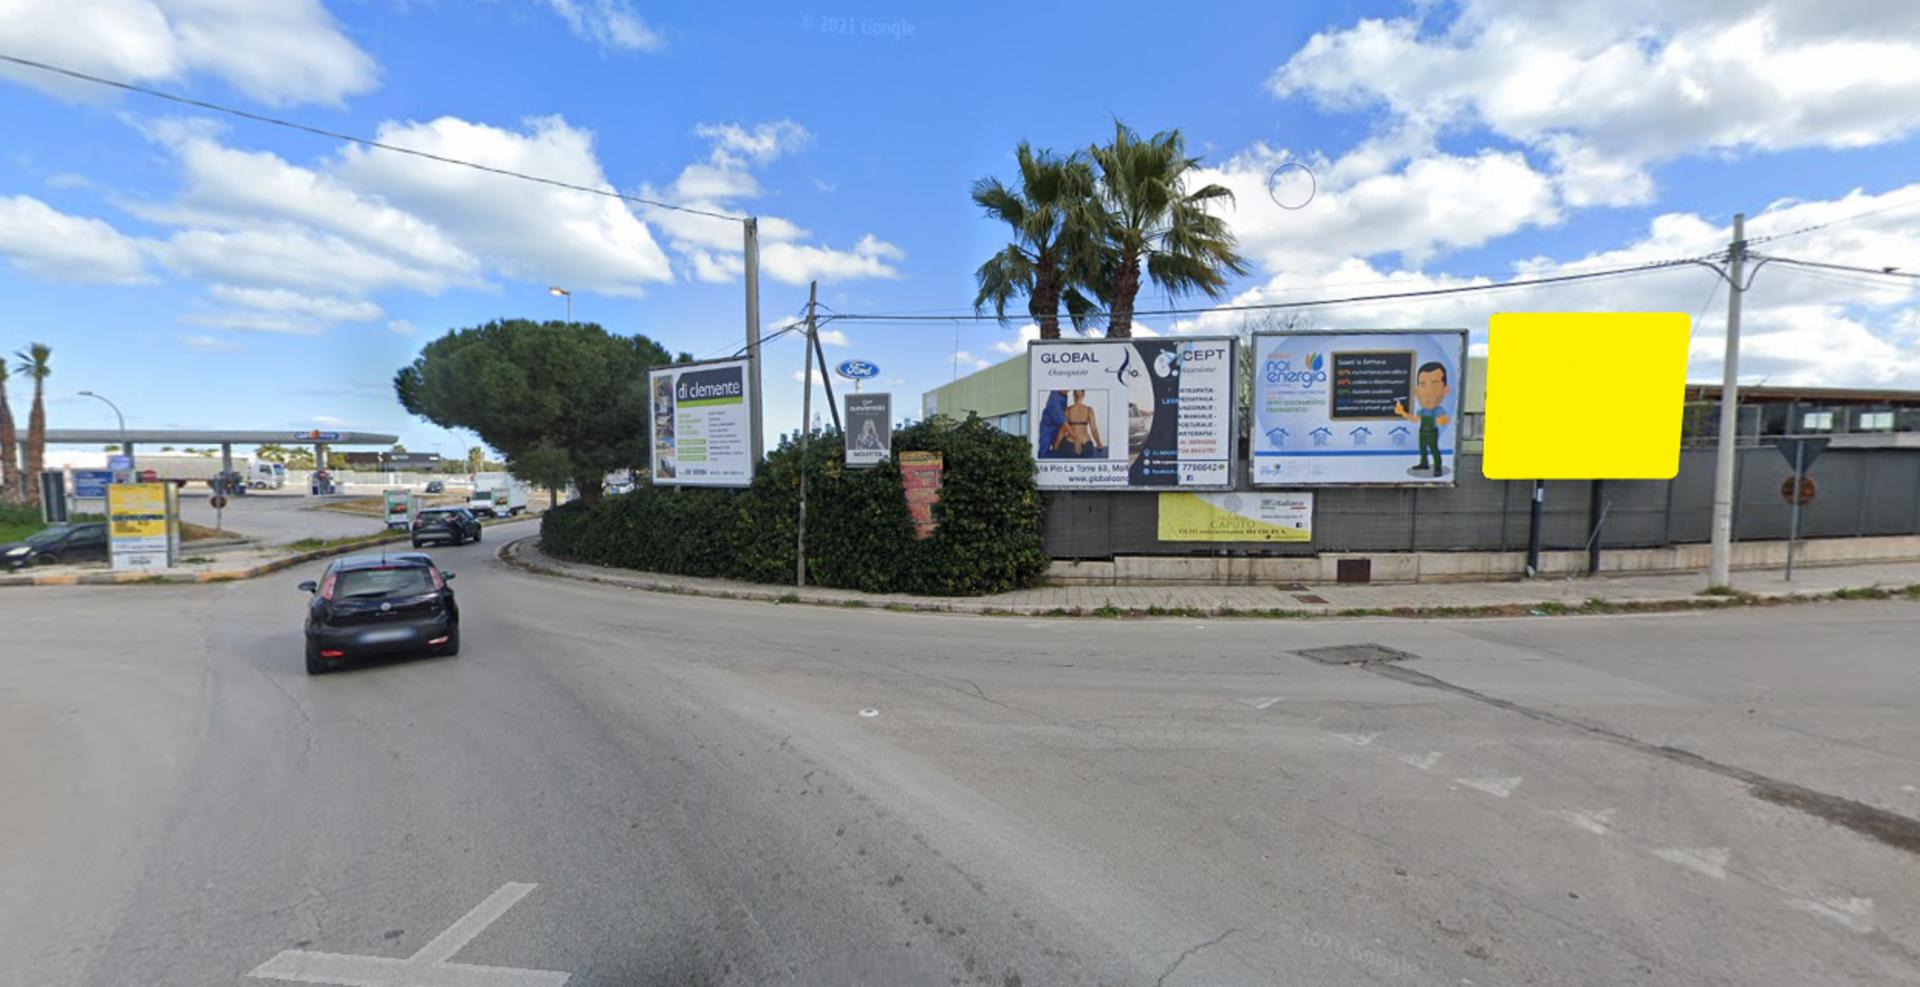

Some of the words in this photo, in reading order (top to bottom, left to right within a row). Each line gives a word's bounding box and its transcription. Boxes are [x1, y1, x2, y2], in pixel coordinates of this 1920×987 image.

[1040, 352, 1100, 364] GLOBAL
[847, 363, 872, 375] Ford
[1266, 360, 1291, 372] noi
[1266, 370, 1327, 389] energia
[679, 383, 688, 399] di
[689, 382, 740, 398] clemente
[1064, 464, 1075, 472] La
